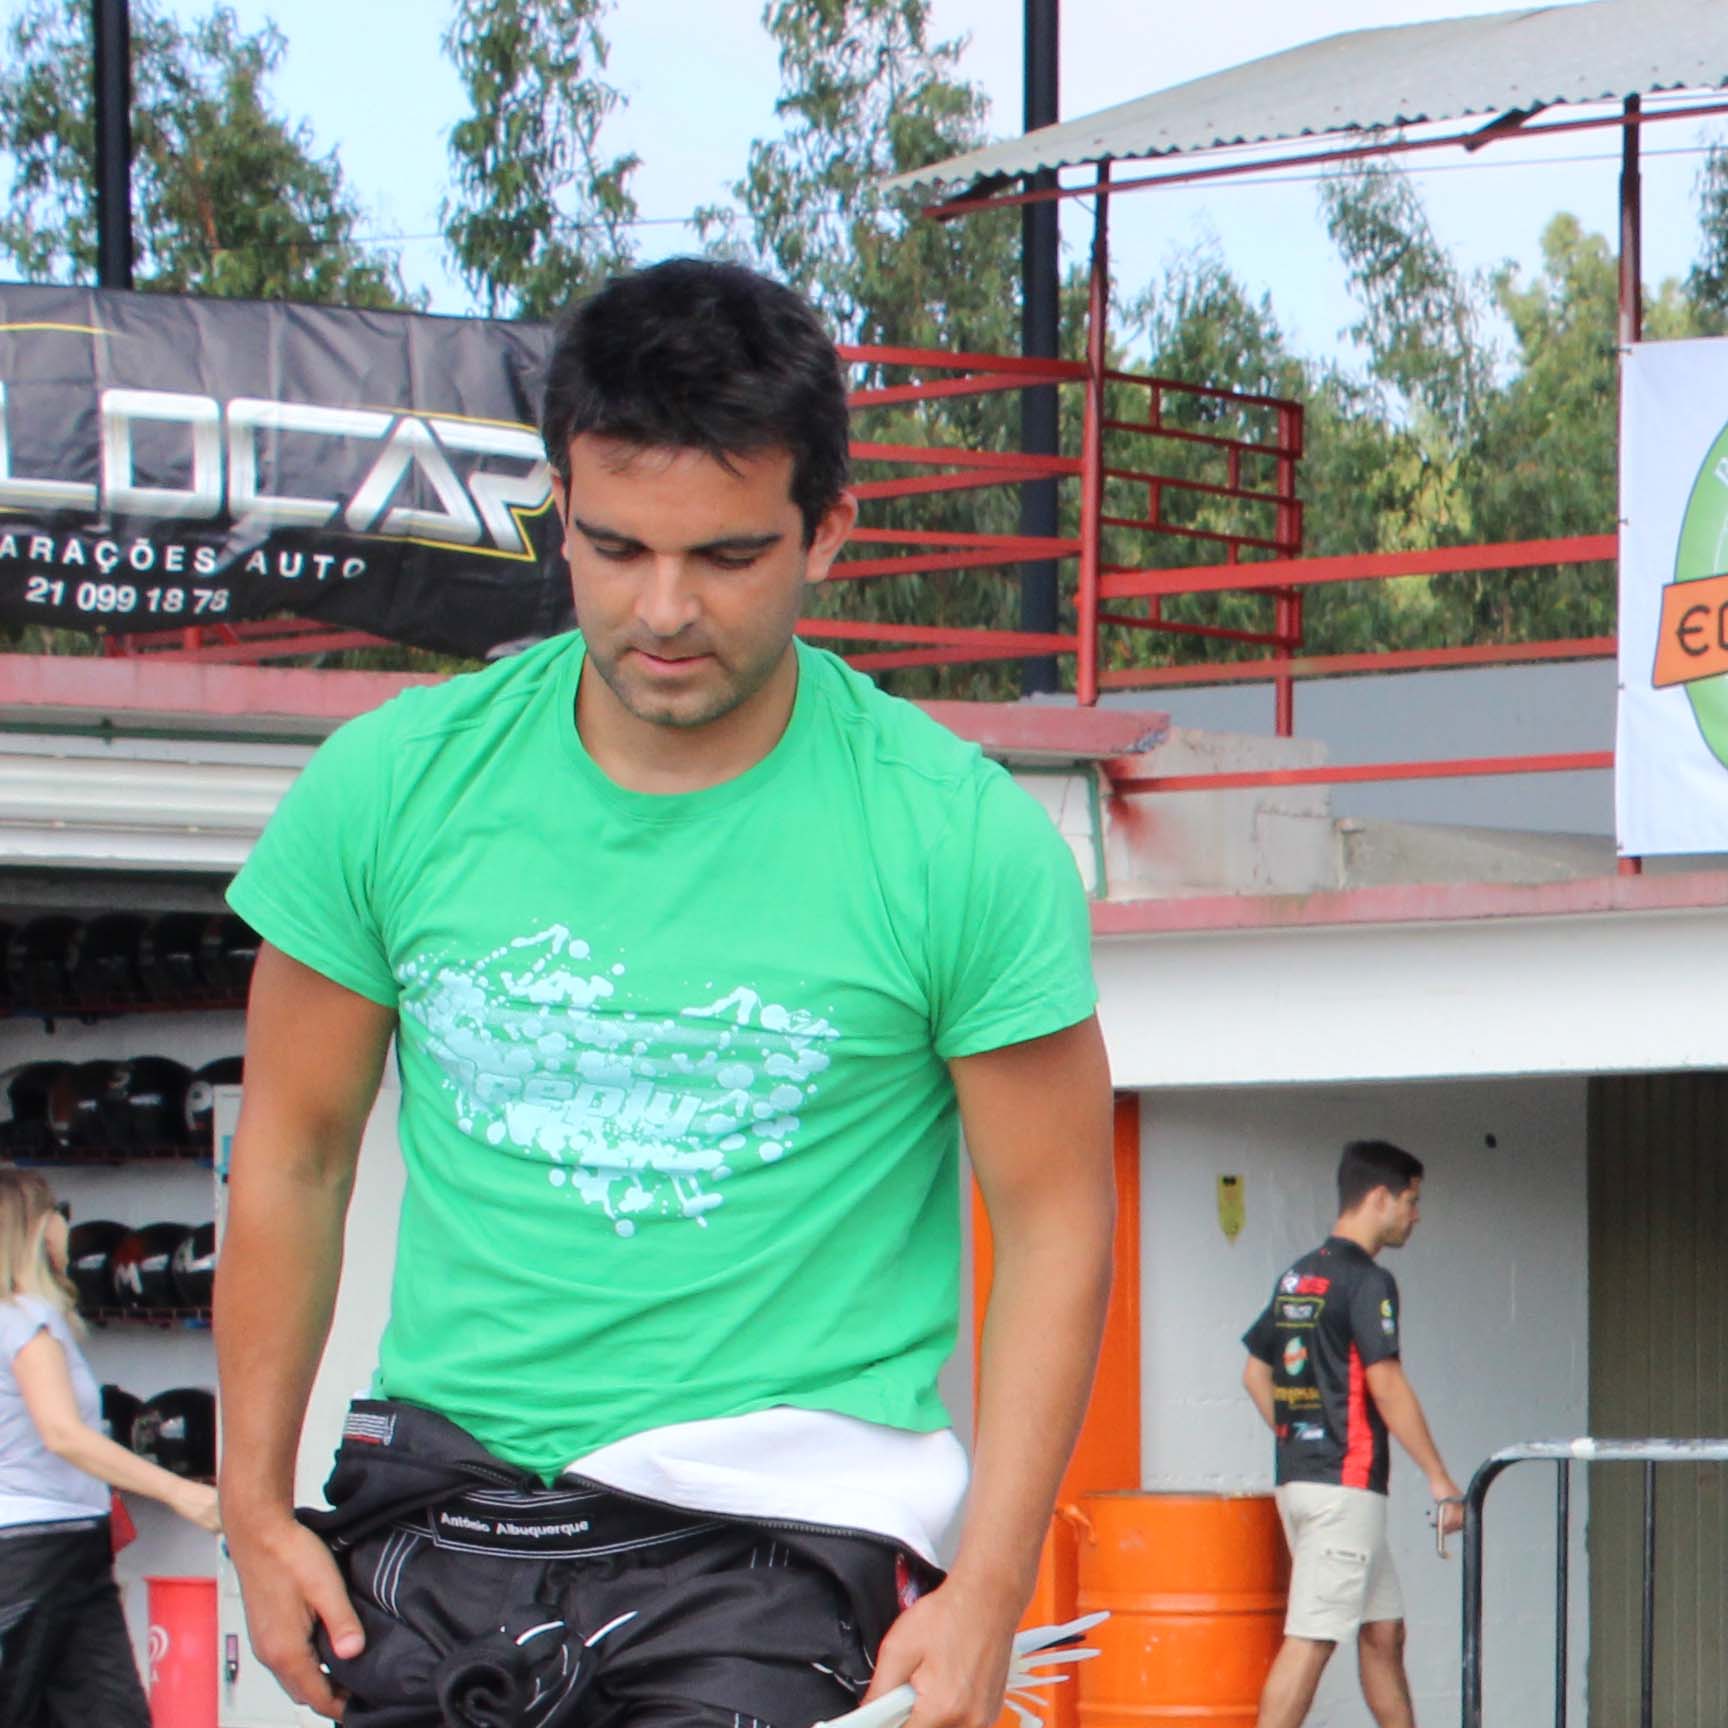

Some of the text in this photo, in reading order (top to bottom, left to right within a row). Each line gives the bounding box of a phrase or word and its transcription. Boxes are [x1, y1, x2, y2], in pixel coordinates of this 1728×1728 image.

[246, 551, 366, 579] AUTO
[25, 576, 64, 605] 21
[76, 583, 137, 613] 099
[147, 588, 184, 612] 18
